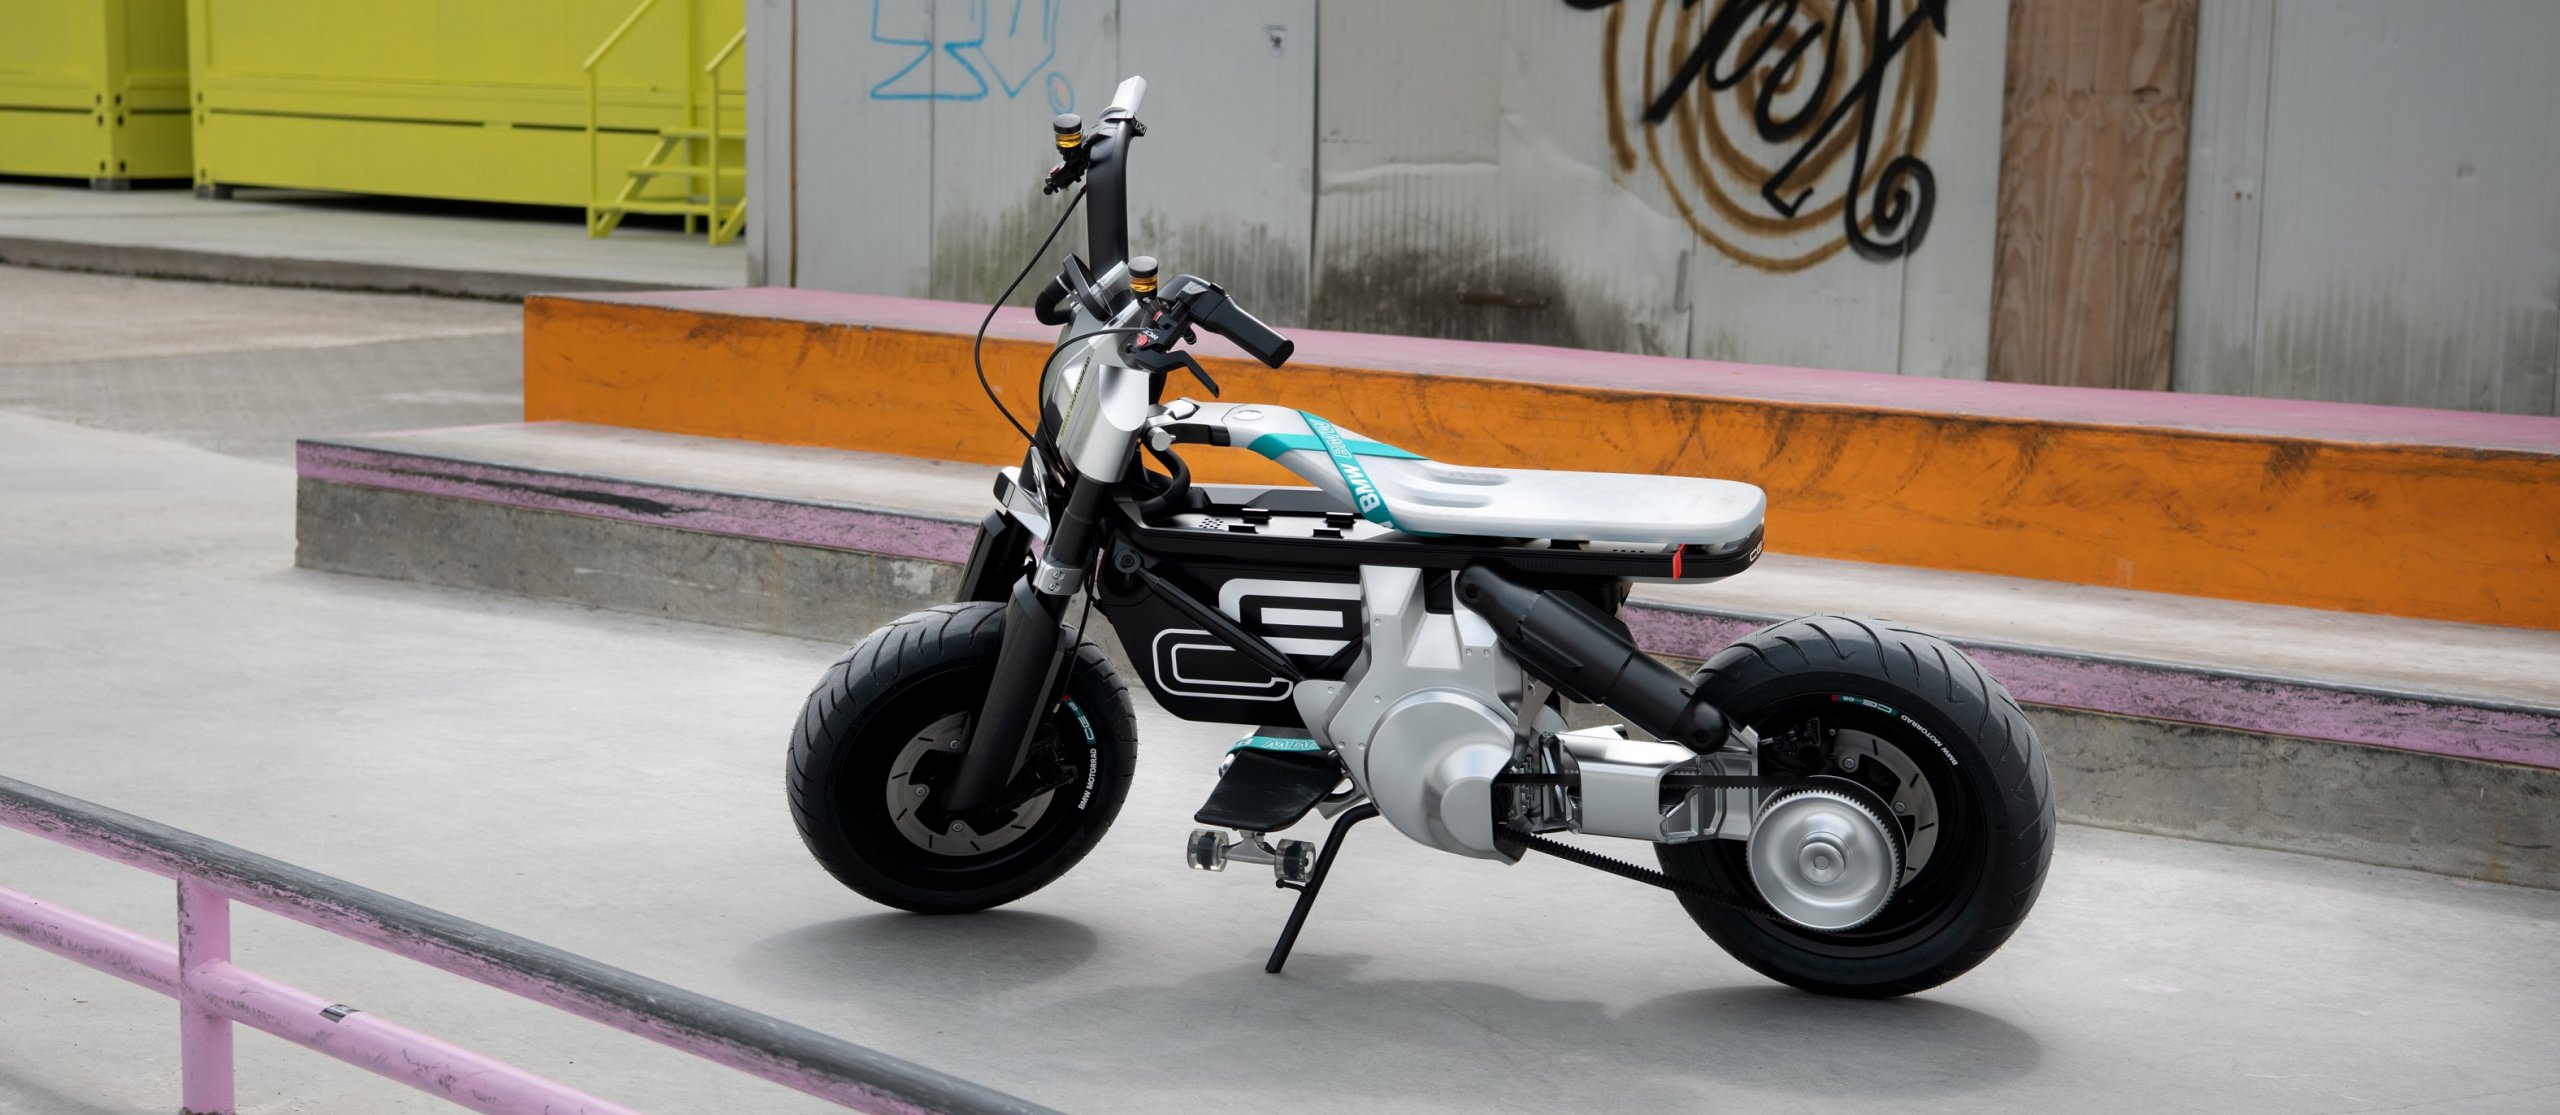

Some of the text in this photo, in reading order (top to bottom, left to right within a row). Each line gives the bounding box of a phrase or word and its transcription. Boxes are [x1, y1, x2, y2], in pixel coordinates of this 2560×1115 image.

[1069, 356, 1091, 411] MOTORRAD
[1341, 463, 1381, 514] BMW
[1901, 714, 1943, 747] MOTORRAD
[1078, 790, 1091, 810] BMW
[1086, 748, 1097, 790] MOTORRAD
[1941, 747, 1958, 766] BMW
